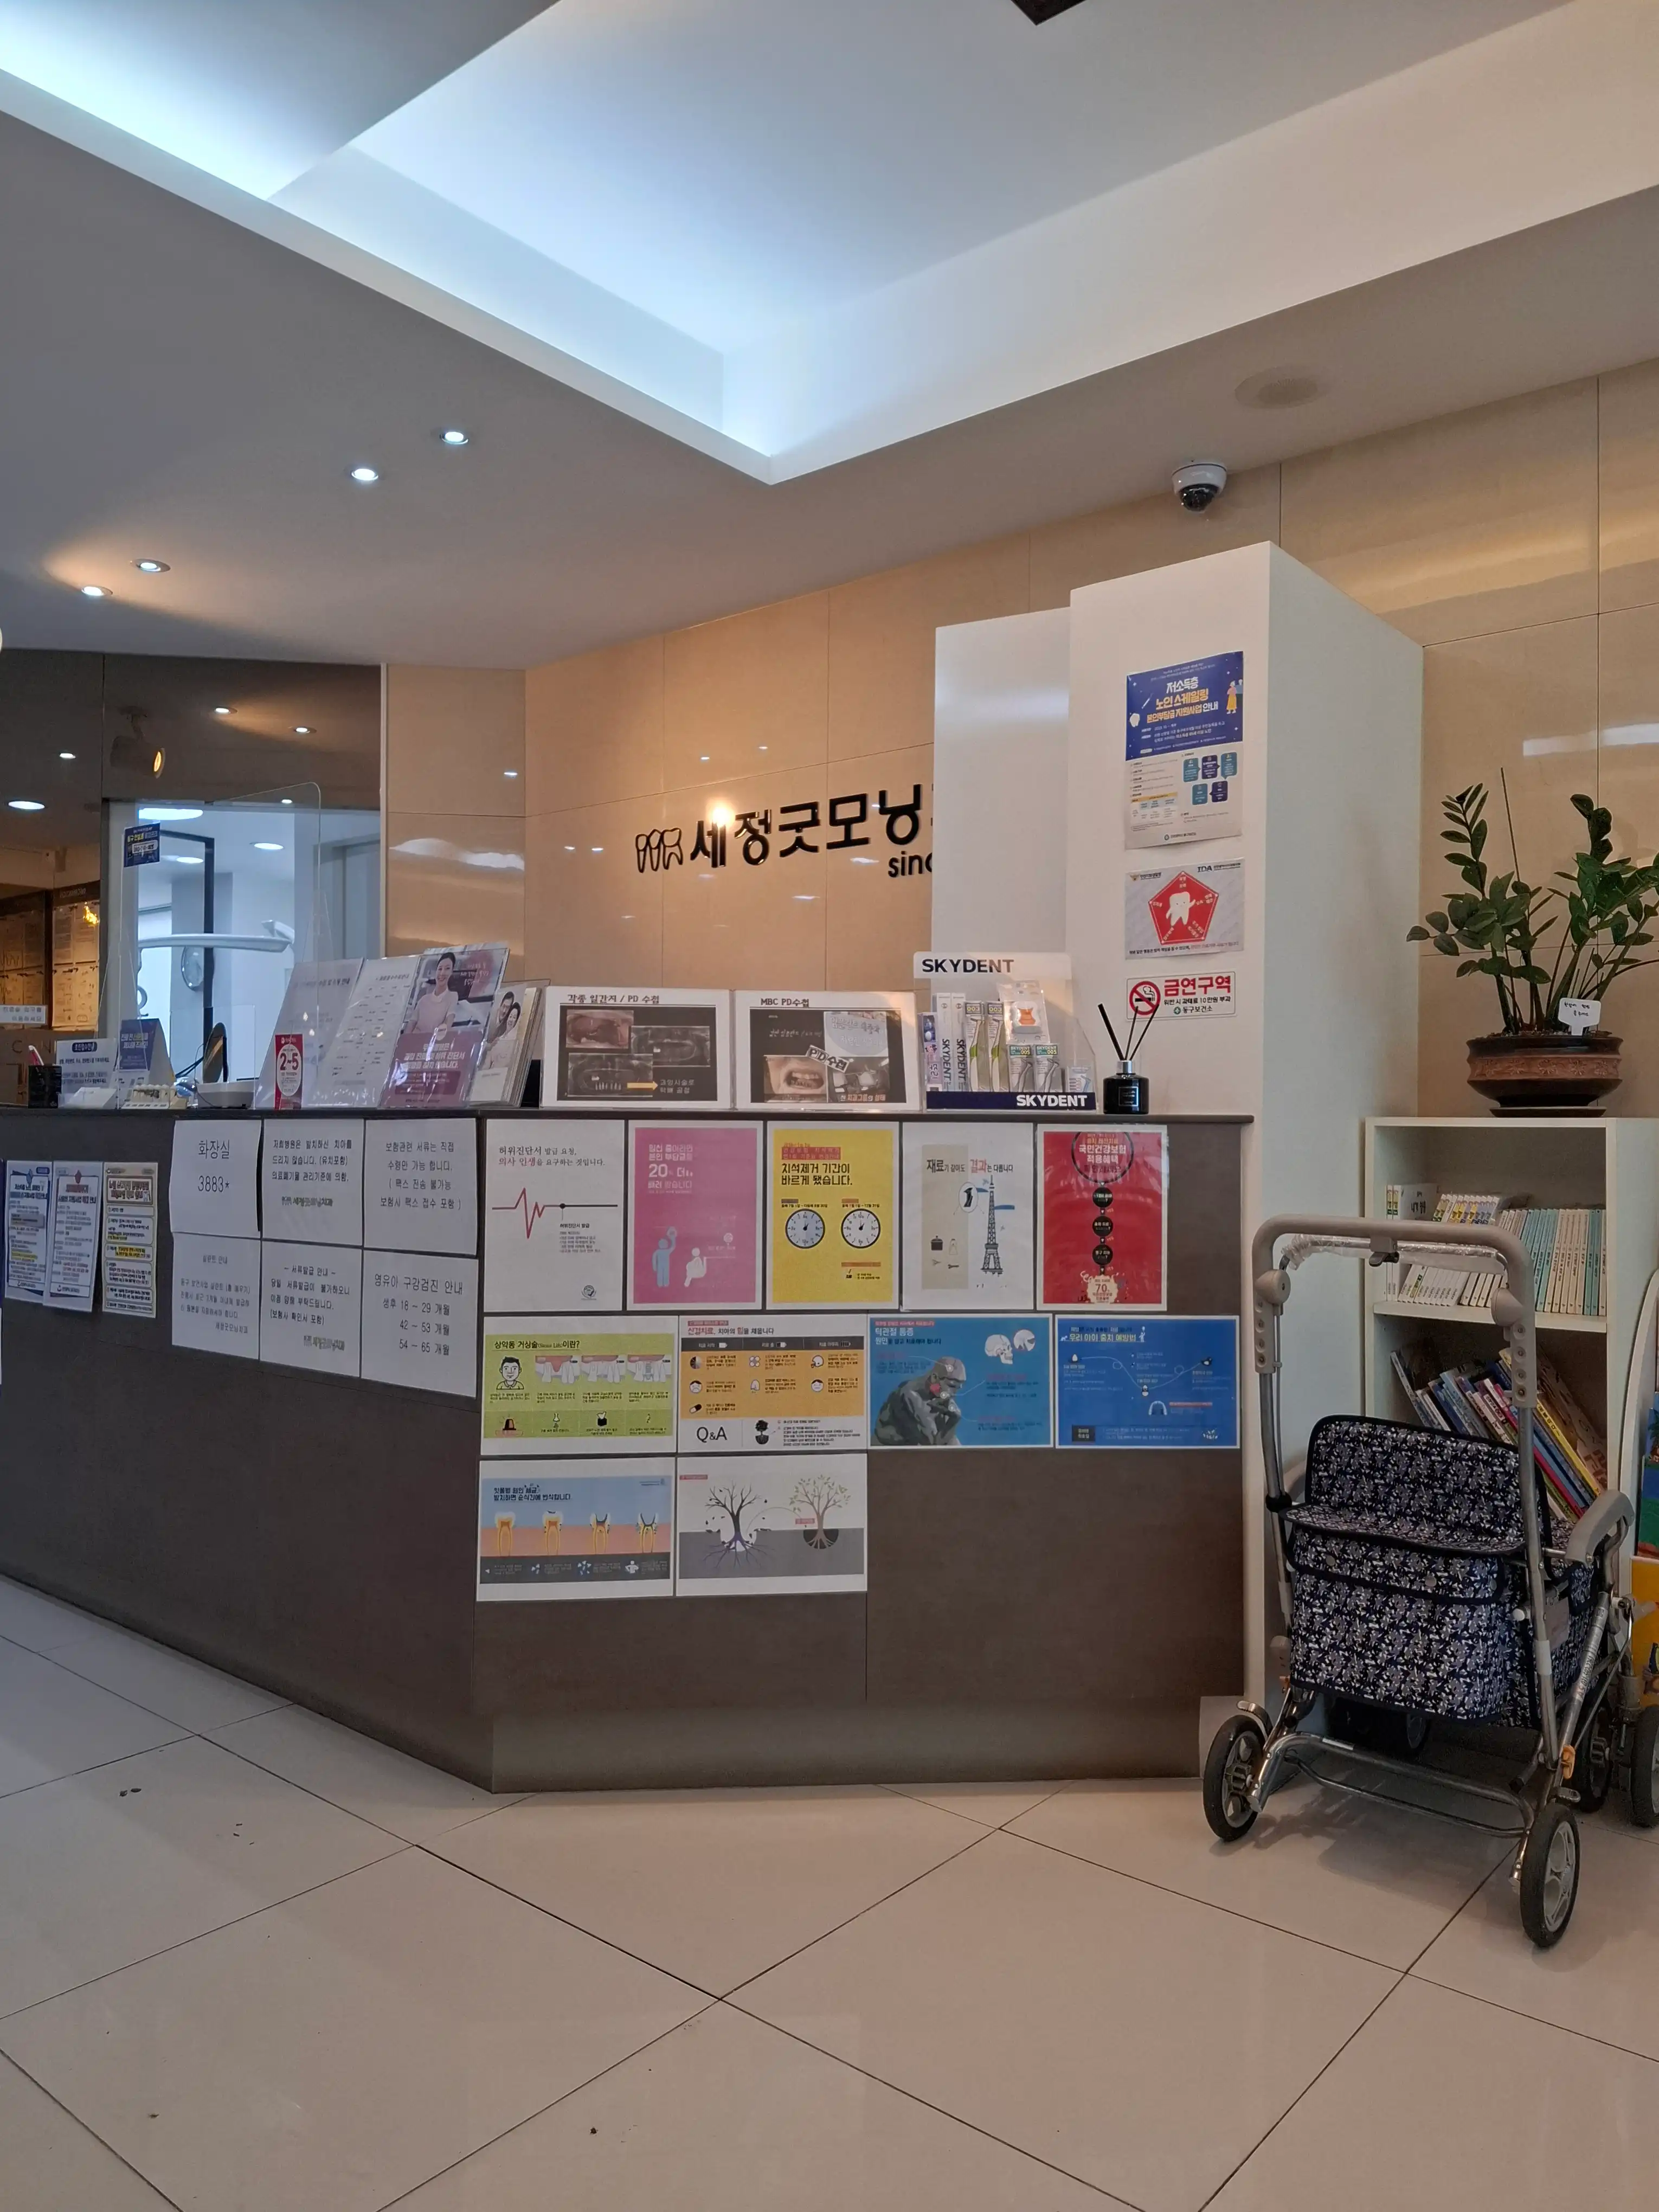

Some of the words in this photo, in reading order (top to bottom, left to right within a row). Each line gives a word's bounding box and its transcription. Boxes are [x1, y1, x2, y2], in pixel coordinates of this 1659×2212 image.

[1166, 677, 1198, 694] 저소득층
[1156, 696, 1173, 710] 노인
[1174, 689, 1208, 706] 스케일링
[1203, 702, 1218, 712] 안내
[690, 784, 934, 867] 세정굿모닝
[922, 959, 1014, 973] SKYDENT
[1164, 975, 1231, 997] 금연구역
[568, 994, 587, 1004] 각종
[589, 994, 617, 1004] 일간지
[642, 995, 659, 1004] 수첩
[942, 1039, 951, 1081] SKYDENT
[956, 1039, 966, 1081] SKYDENT
[1016, 1095, 1087, 1107] SKYDENT
[198, 1139, 230, 1159] 화장실
[273, 1140, 301, 1149] 저희병원은
[306, 1140, 329, 1149] 발치하신
[334, 1140, 352, 1149] 치아를
[386, 1142, 413, 1152] 보험관련
[416, 1142, 436, 1152] 서류는
[1079, 1144, 1126, 1154] 국민건강보험
[499, 1146, 542, 1155] 허위진단서
[273, 1155, 288, 1164] 드리지
[292, 1156, 317, 1165] 않습니다.
[499, 1157, 516, 1166] 의사
[1087, 1155, 1118, 1164] 적용혜택
[388, 1160, 408, 1171] 수령만
[412, 1161, 425, 1171] 가능
[429, 1160, 453, 1171] 합니다.
[782, 1163, 819, 1174] 치석제거
[822, 1163, 850, 1174] 기간이
[927, 1159, 949, 1172] 재료가
[970, 1159, 992, 1173] 결과는
[272, 1172, 299, 1181] 의료폐기물
[782, 1175, 809, 1185] 바르게
[813, 1175, 852, 1185] 됐습니다.
[396, 1179, 409, 1188] 팩스
[413, 1179, 426, 1189] 전송
[430, 1179, 451, 1190] 불가능
[405, 1198, 419, 1207] 팩스
[423, 1198, 436, 1208] 접수
[441, 1198, 454, 1209] 포함
[292, 1265, 314, 1276] 서류발급
[317, 1268, 328, 1276] 안내
[287, 1281, 315, 1291] 서류발급이
[321, 1285, 350, 1295] 불가하오니
[375, 1274, 398, 1288] 영유아
[404, 1277, 439, 1293] 구강검진
[445, 1281, 462, 1295] 안내
[383, 1298, 396, 1309] 생후
[401, 1300, 409, 1311] 18
[422, 1302, 431, 1313] 29
[435, 1304, 450, 1316] 개월
[400, 1320, 408, 1330] 42
[421, 1322, 430, 1333] 53
[435, 1323, 449, 1336] 개월
[1069, 1333, 1082, 1341] 우리
[1084, 1333, 1098, 1341] 아이
[399, 1339, 408, 1349] 54
[421, 1342, 430, 1352] 65
[435, 1343, 449, 1355] 개월
[494, 1341, 515, 1349] 상악동
[697, 1426, 728, 1443] Q&A
